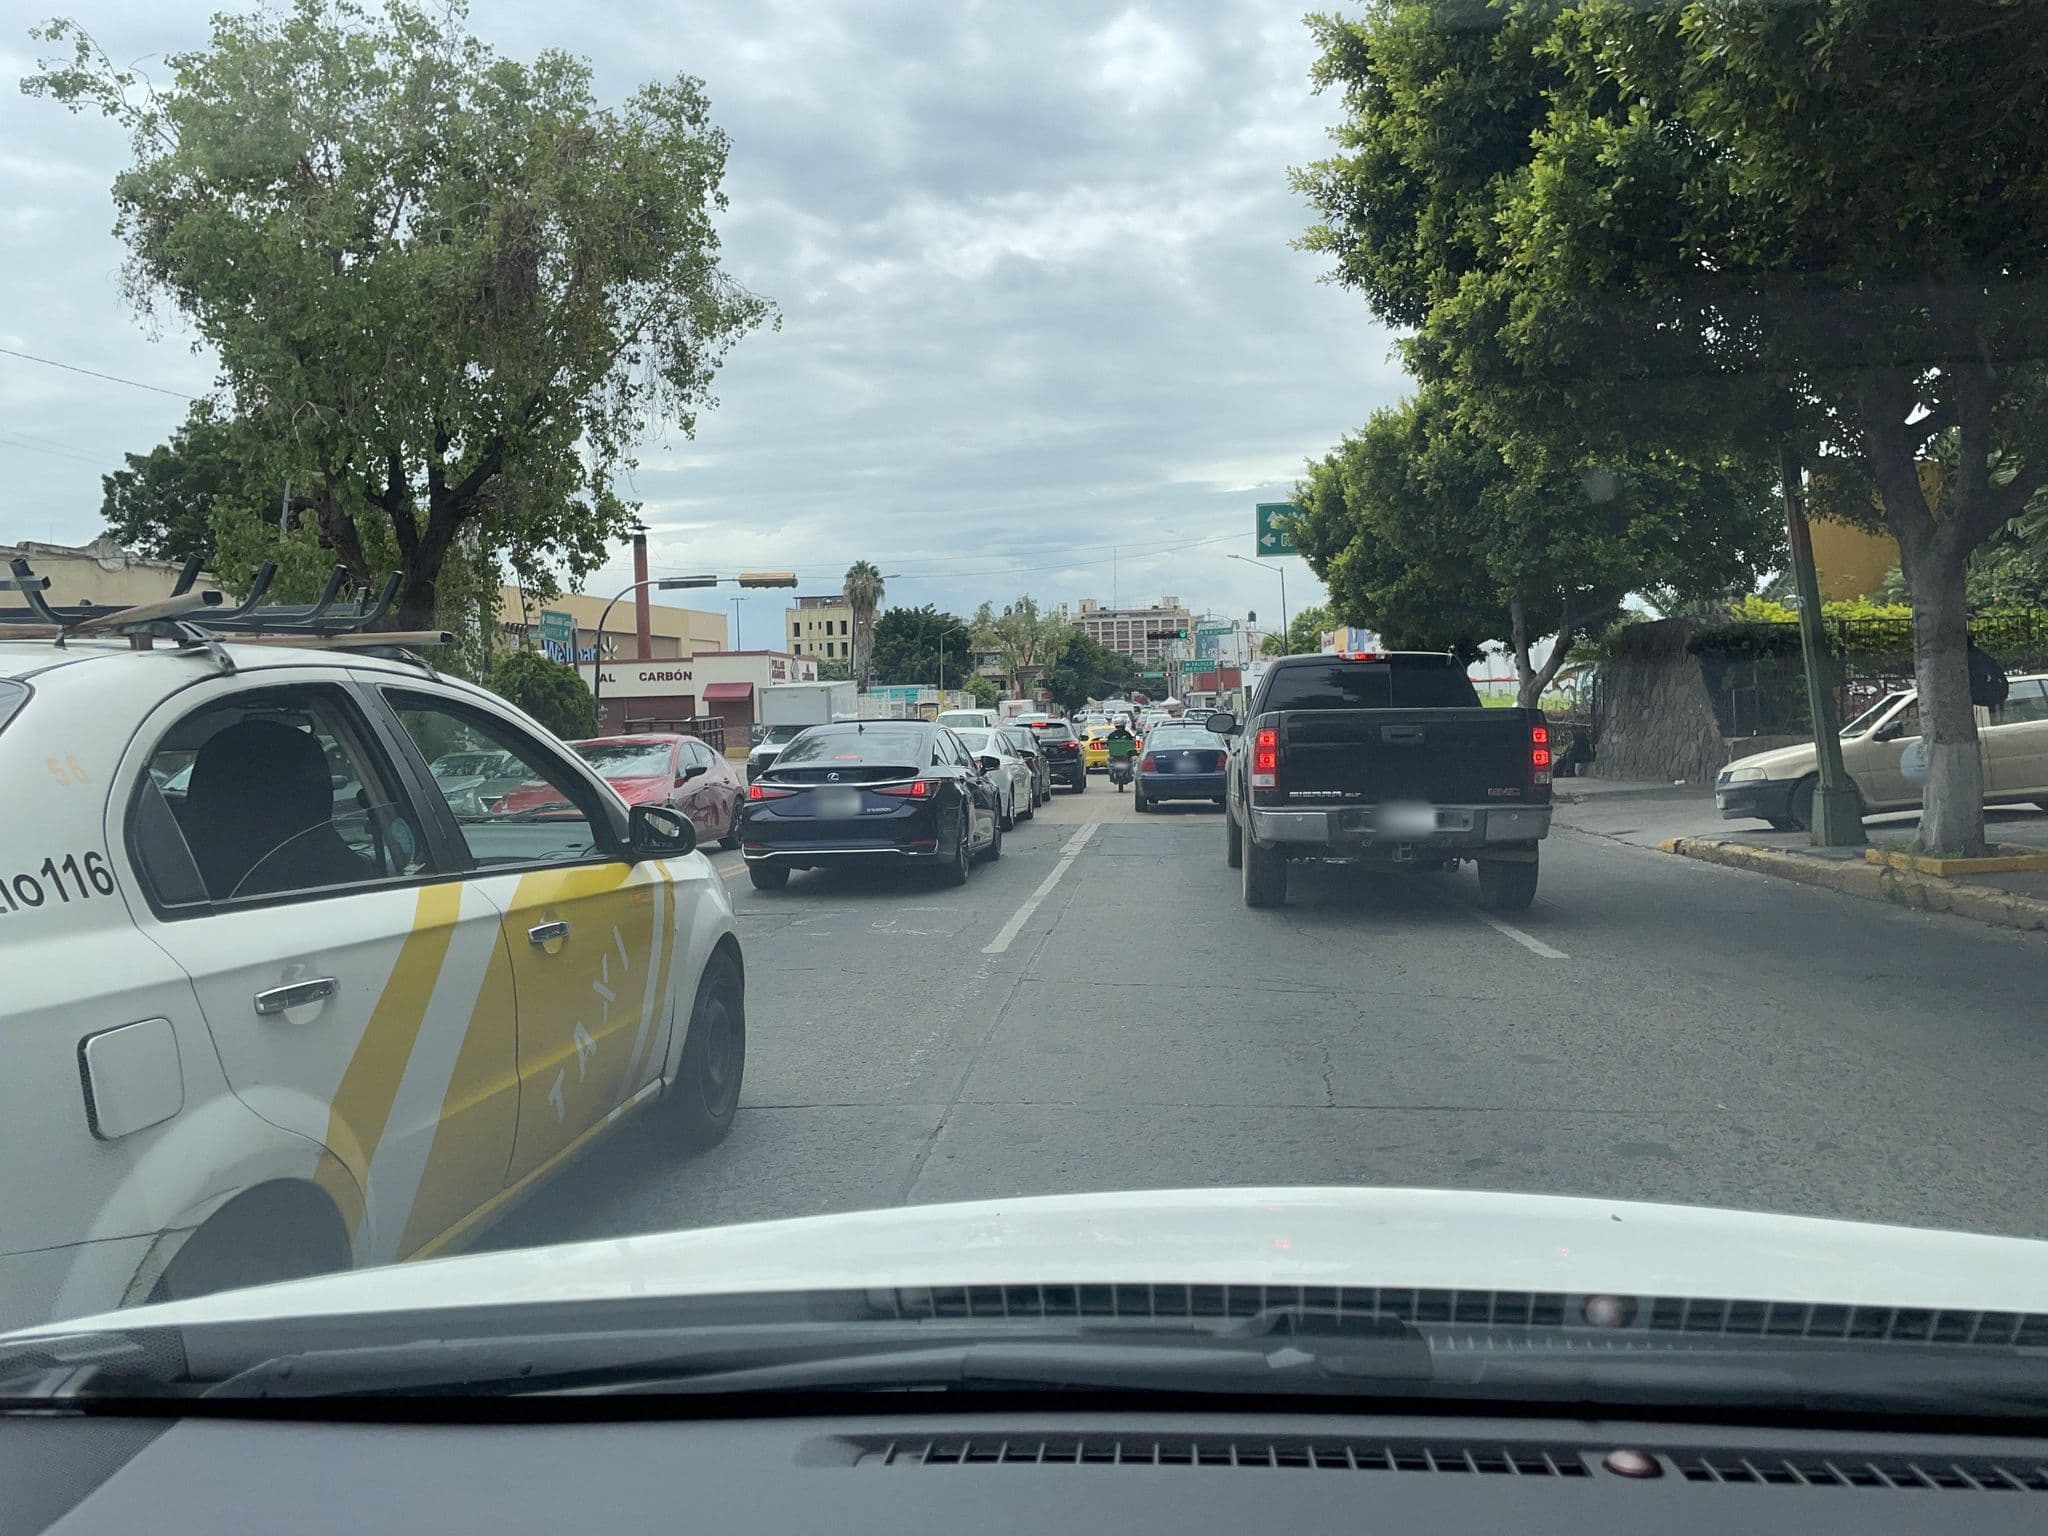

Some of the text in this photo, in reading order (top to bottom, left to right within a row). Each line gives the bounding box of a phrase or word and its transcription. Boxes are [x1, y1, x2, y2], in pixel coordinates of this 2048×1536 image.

[599, 669, 692, 683] AL CARBÓN
[1488, 788, 1520, 796] GMC
[548, 925, 630, 1123] TAXI
